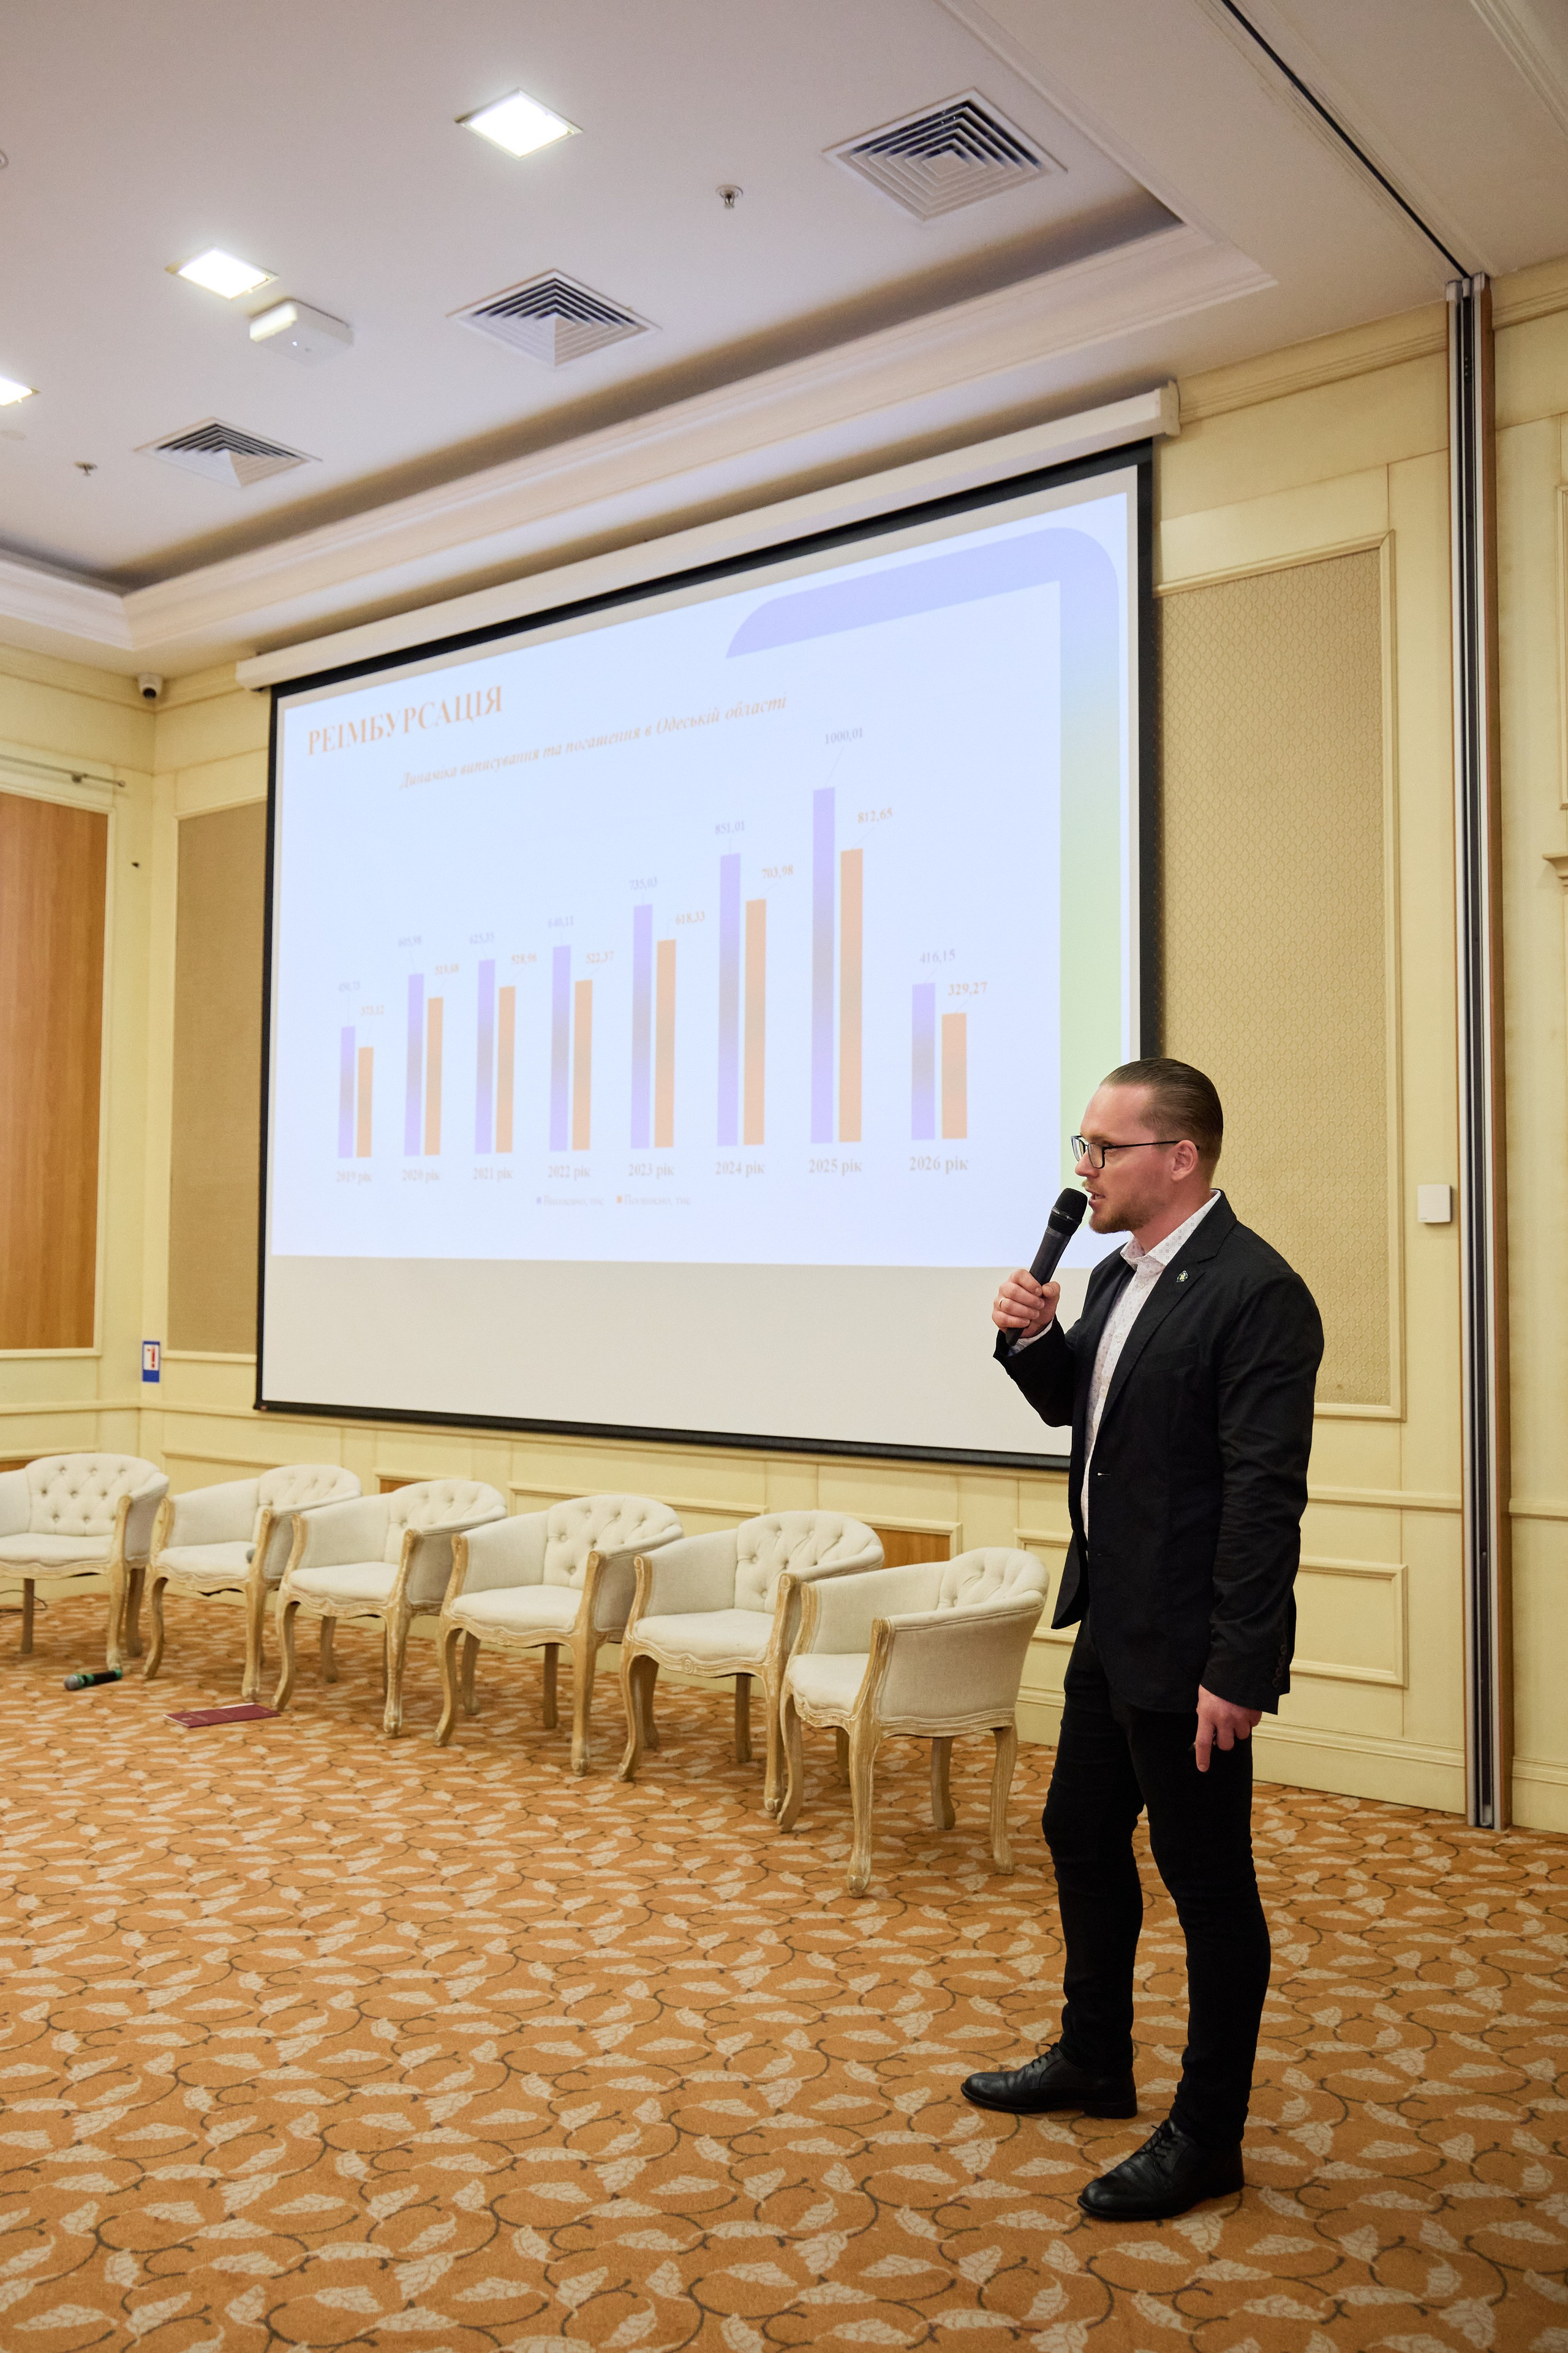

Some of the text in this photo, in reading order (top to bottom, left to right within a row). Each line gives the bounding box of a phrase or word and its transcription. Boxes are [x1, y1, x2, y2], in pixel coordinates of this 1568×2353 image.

[308, 686, 502, 755] РЕІМБУРСАЦІЯ
[543, 744, 562, 758] та
[566, 727, 640, 753] погашення
[644, 723, 651, 737] в
[656, 708, 720, 735] Одеській
[725, 691, 787, 720] області
[824, 727, 863, 744] 1000,01
[858, 806, 893, 823] 812,65
[714, 820, 745, 835] 851,01
[761, 864, 794, 879] 703,98
[919, 948, 956, 965] 416,15
[948, 981, 987, 996] 329,27
[473, 1166, 493, 1180] 2021
[548, 1165, 591, 1181] 2022 рік
[628, 1163, 674, 1180] 2023 рік
[715, 1160, 765, 1178] 2024 рік
[809, 1158, 862, 1176] 2025 рік
[909, 1155, 969, 1175] 2026 рік
